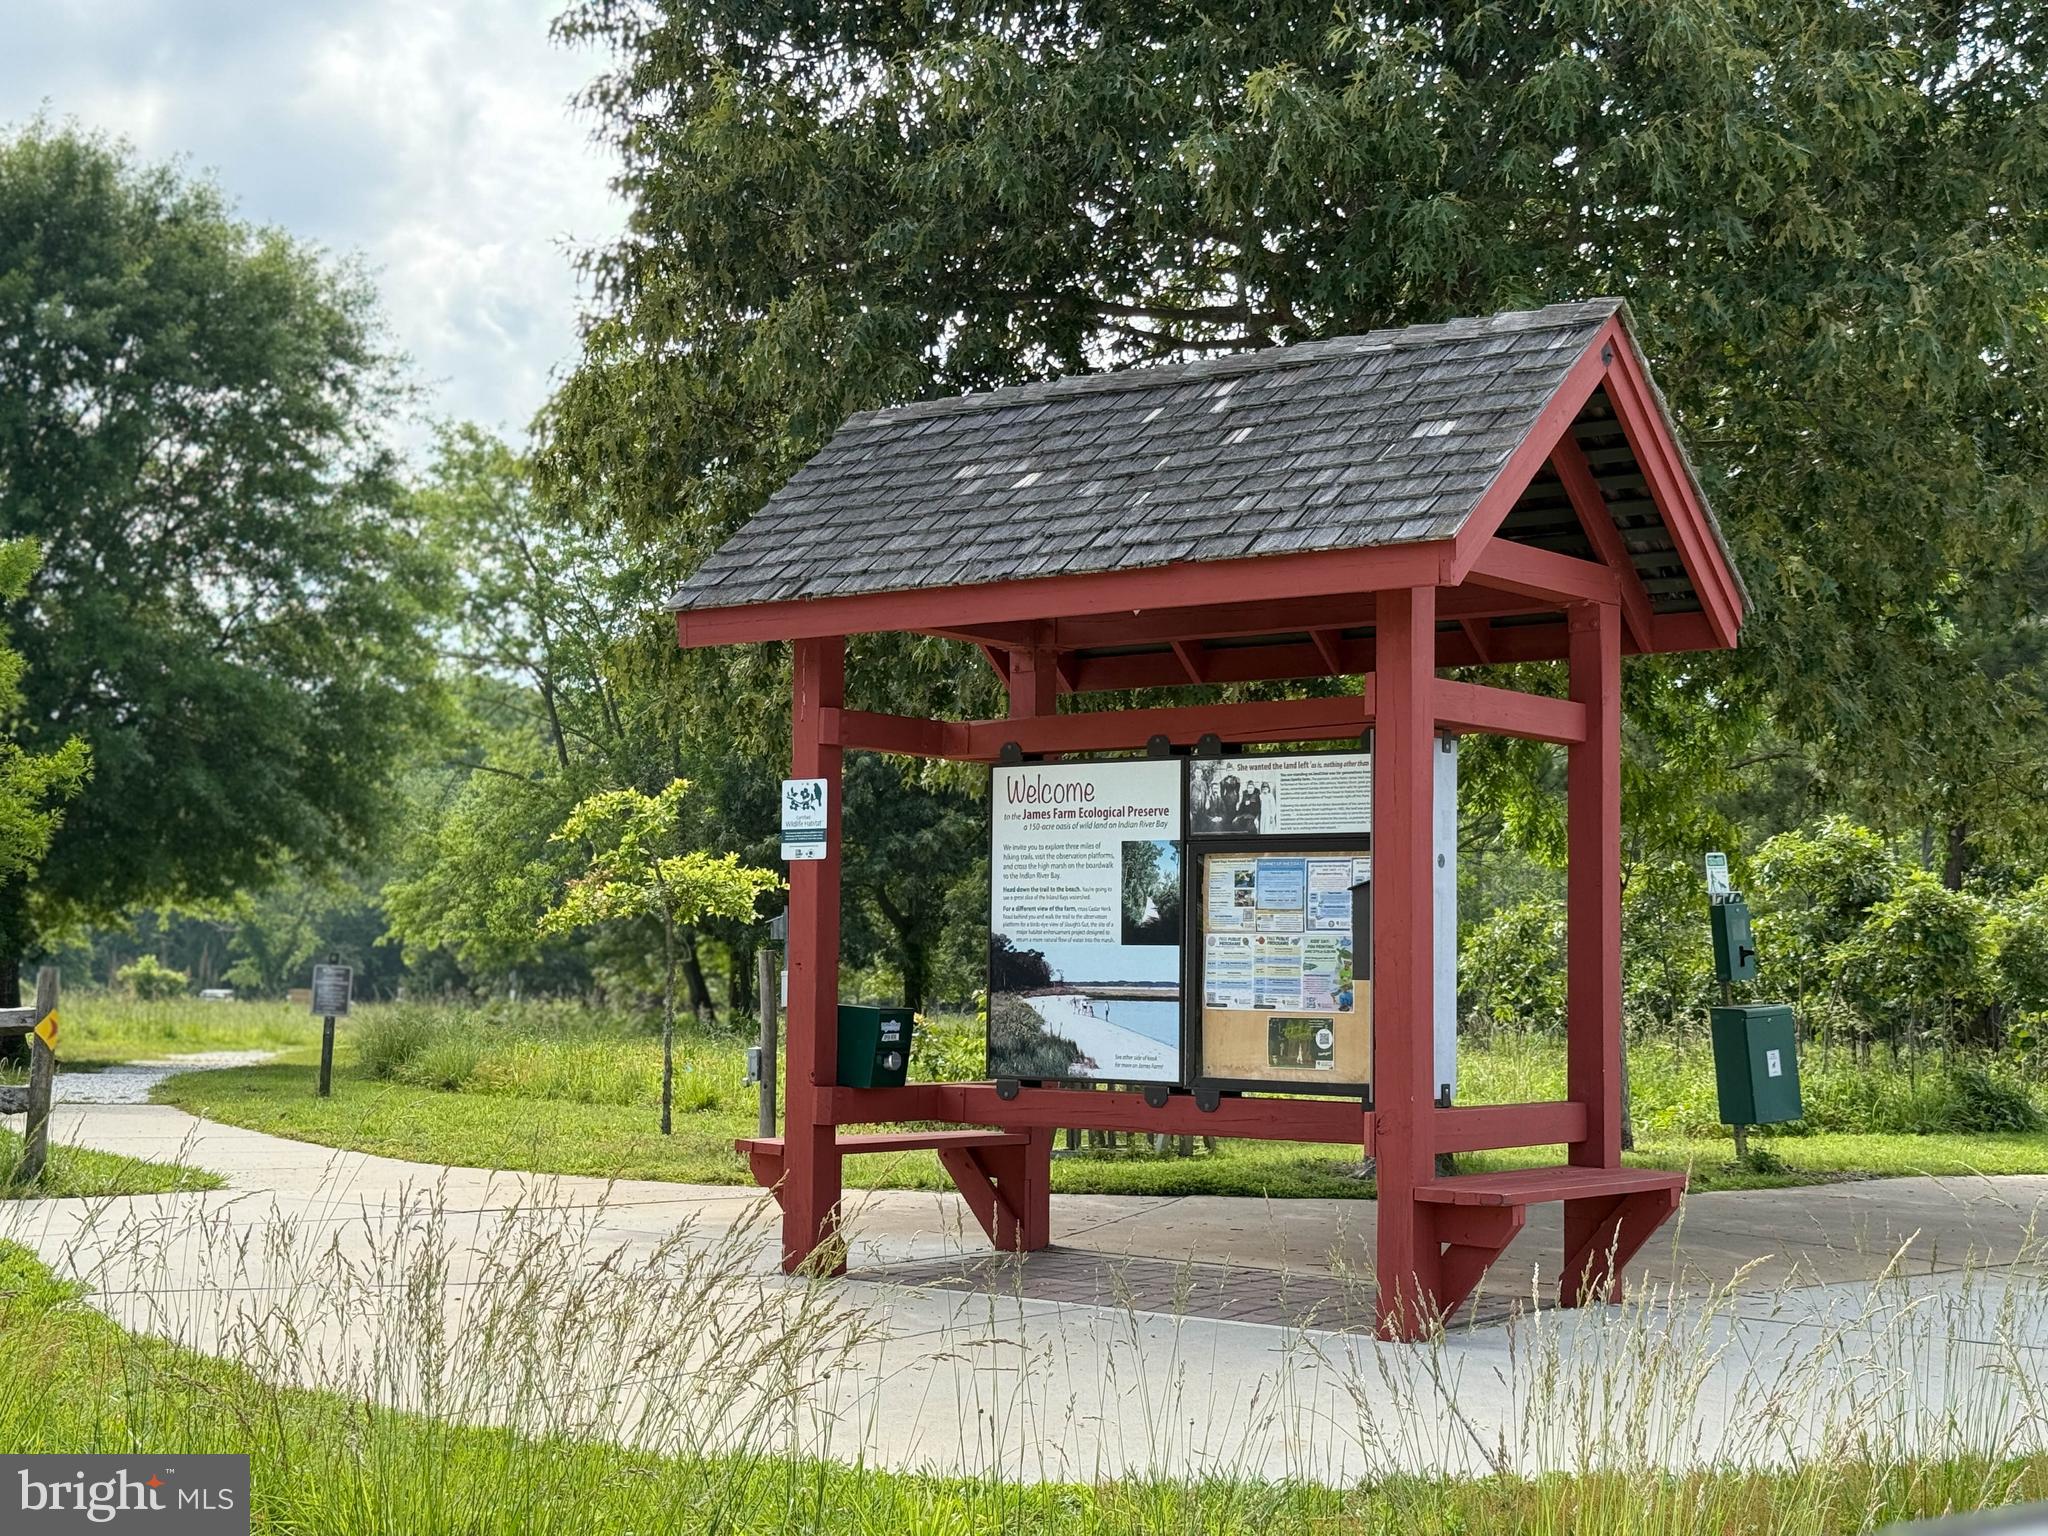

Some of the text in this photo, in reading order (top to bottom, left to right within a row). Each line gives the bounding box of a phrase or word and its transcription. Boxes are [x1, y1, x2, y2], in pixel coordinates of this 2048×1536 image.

[1007, 774, 1095, 804] Welcome
[1012, 812, 1021, 820] the
[1022, 809, 1050, 820] James
[1054, 808, 1076, 819] Farm
[1079, 806, 1125, 821] Ecological
[1128, 806, 1170, 817] Preserve
[1156, 820, 1168, 829] Bay
[1045, 843, 1064, 851] explore
